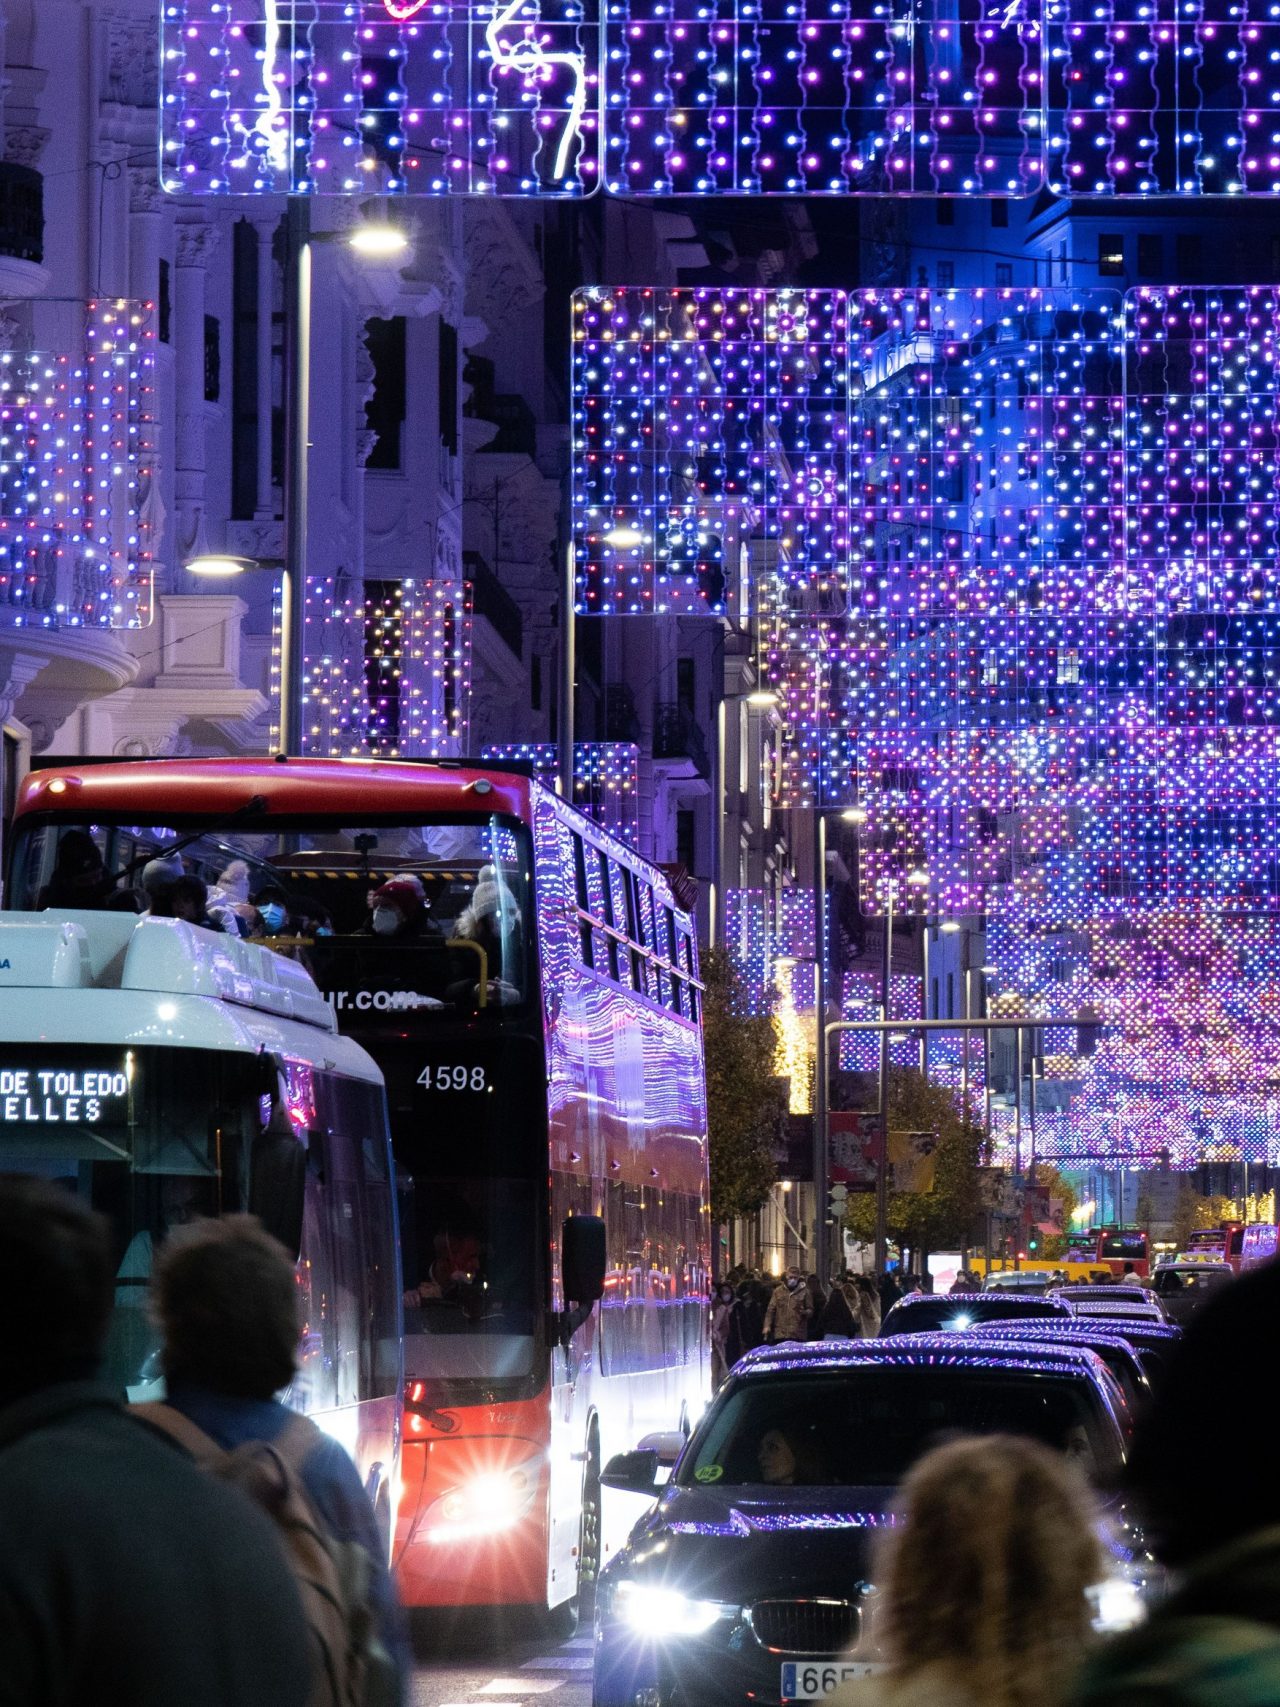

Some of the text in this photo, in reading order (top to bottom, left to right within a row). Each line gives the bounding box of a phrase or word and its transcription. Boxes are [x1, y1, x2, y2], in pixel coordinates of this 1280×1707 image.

[0, 1072, 127, 1096] DE TOLEDO
[416, 1065, 486, 1091] 4598
[5, 1097, 100, 1121] ELLES
